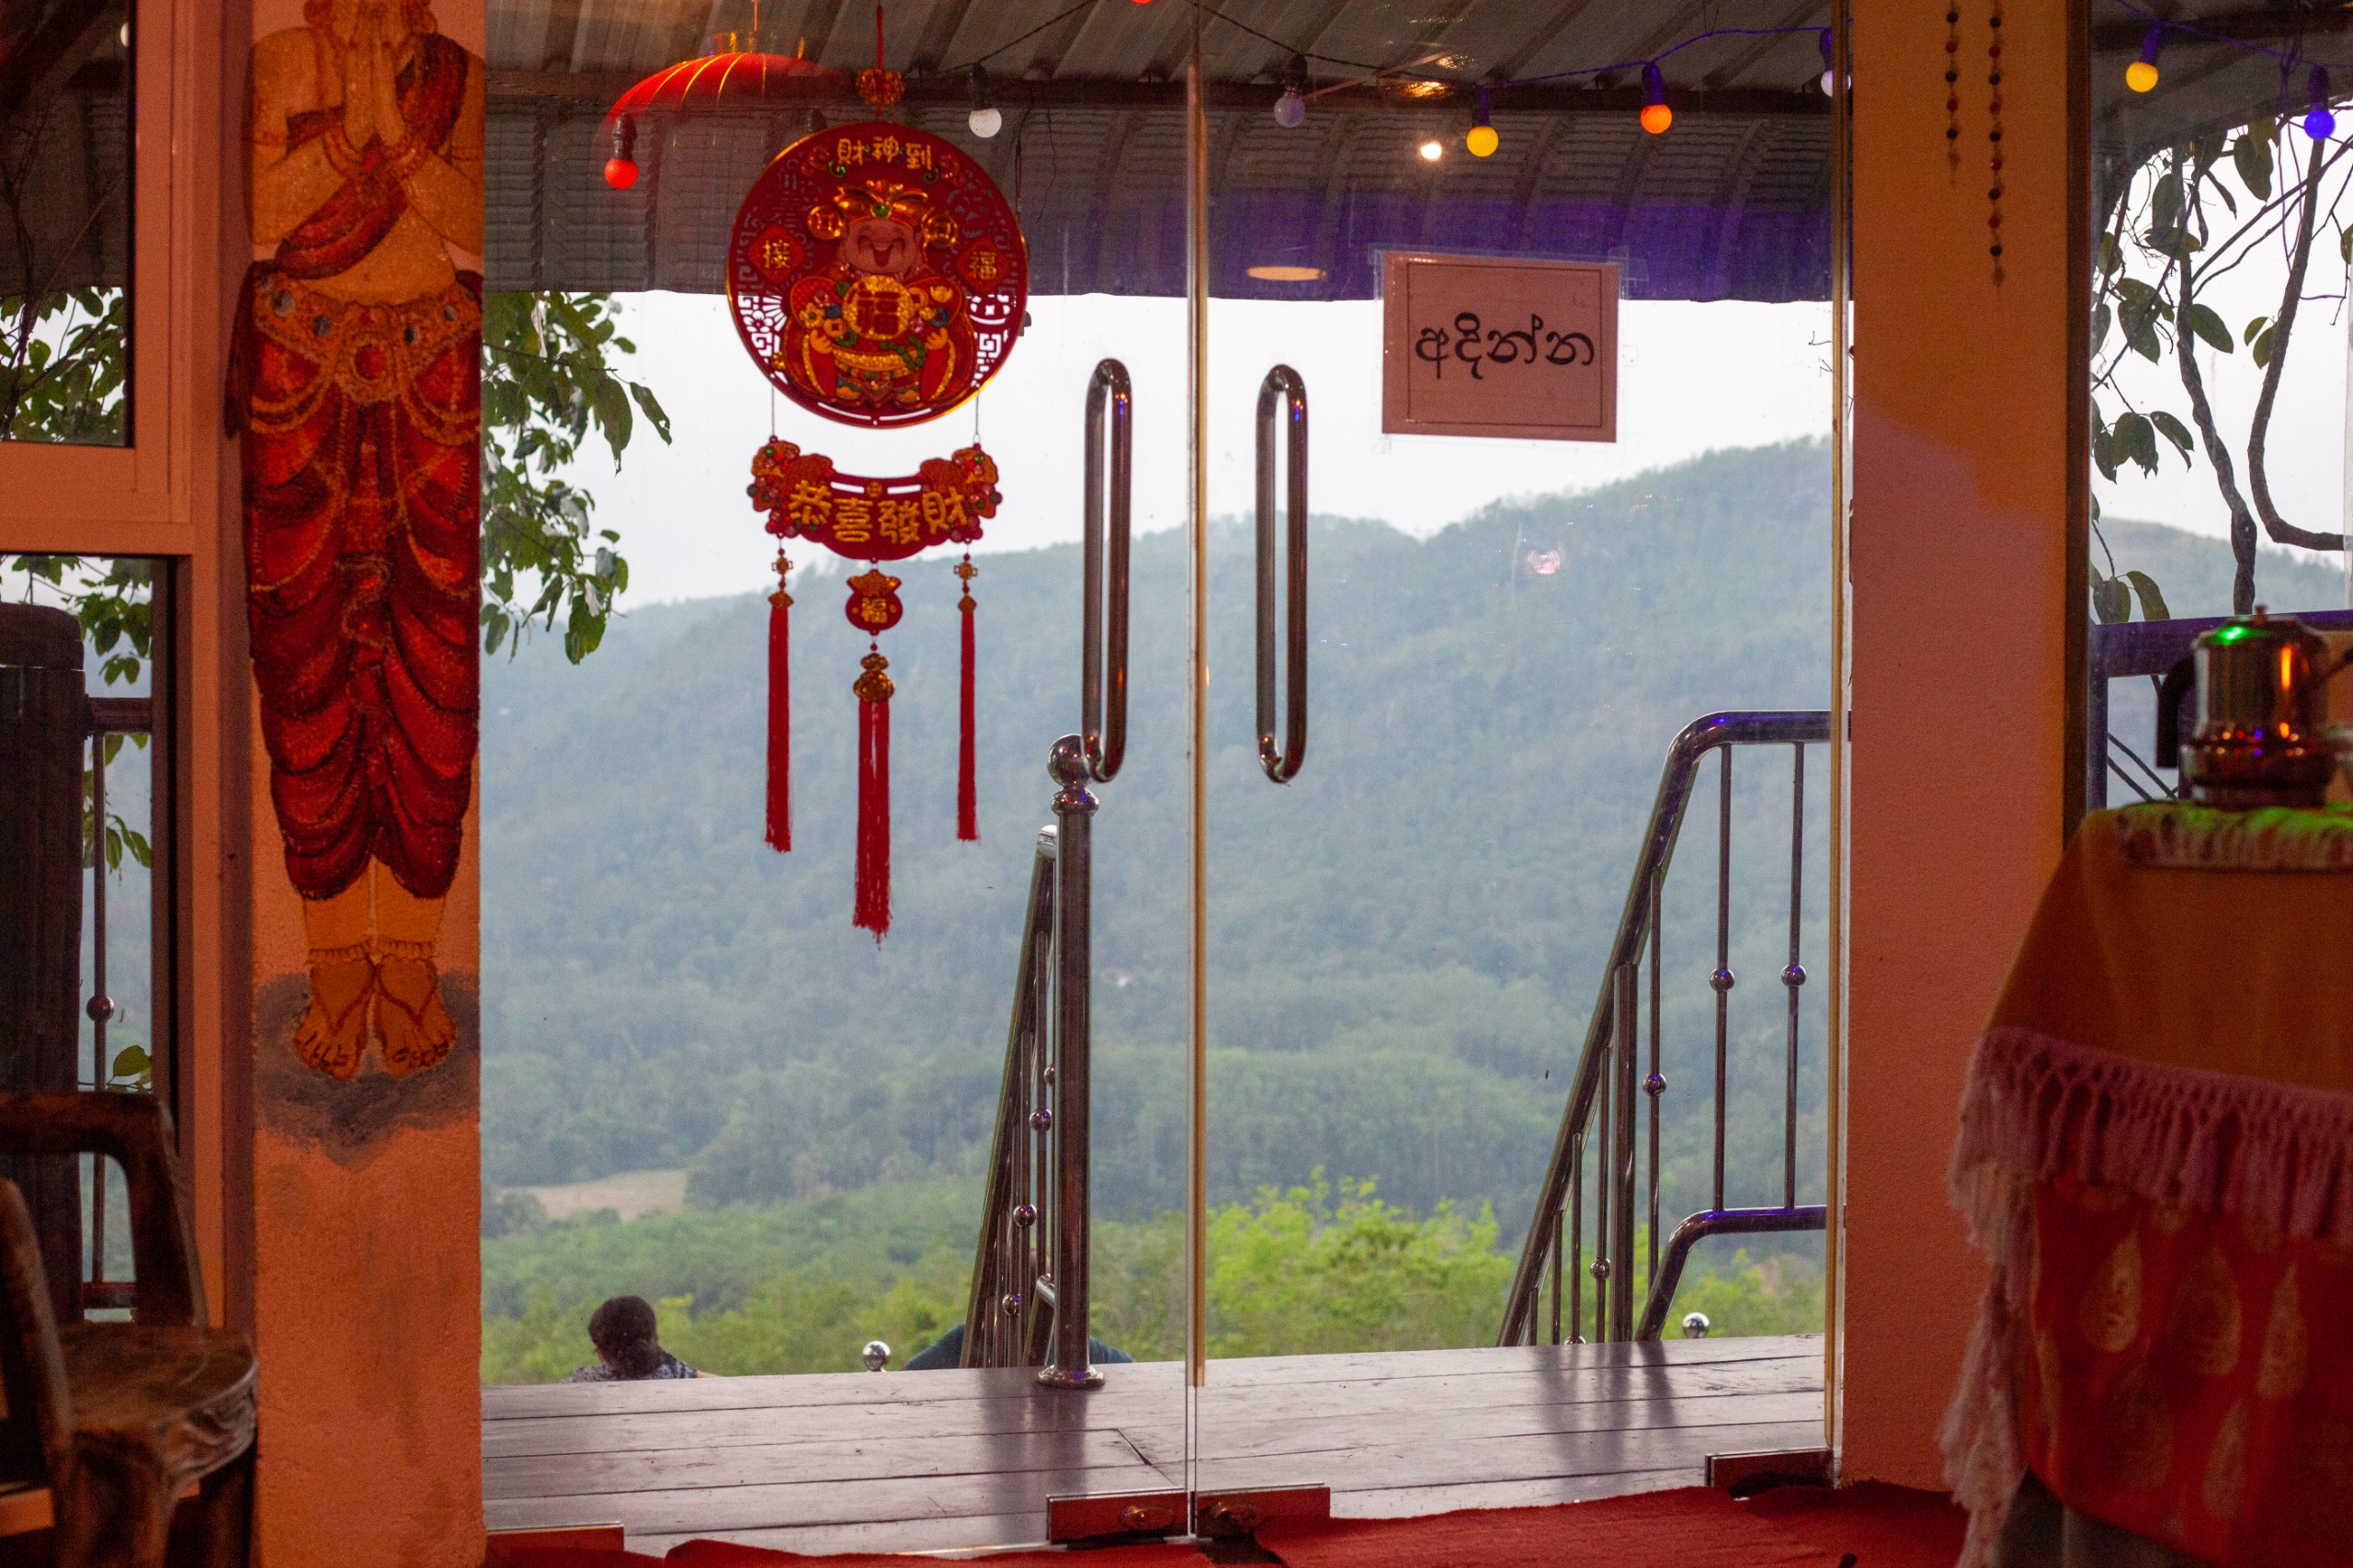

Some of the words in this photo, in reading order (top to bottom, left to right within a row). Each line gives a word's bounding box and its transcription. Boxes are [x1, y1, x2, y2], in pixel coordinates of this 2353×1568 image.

[837, 135, 933, 171] 財神到
[969, 251, 997, 280] 福
[1415, 311, 1596, 381] අදින්න
[788, 479, 968, 545] 恭喜發財
